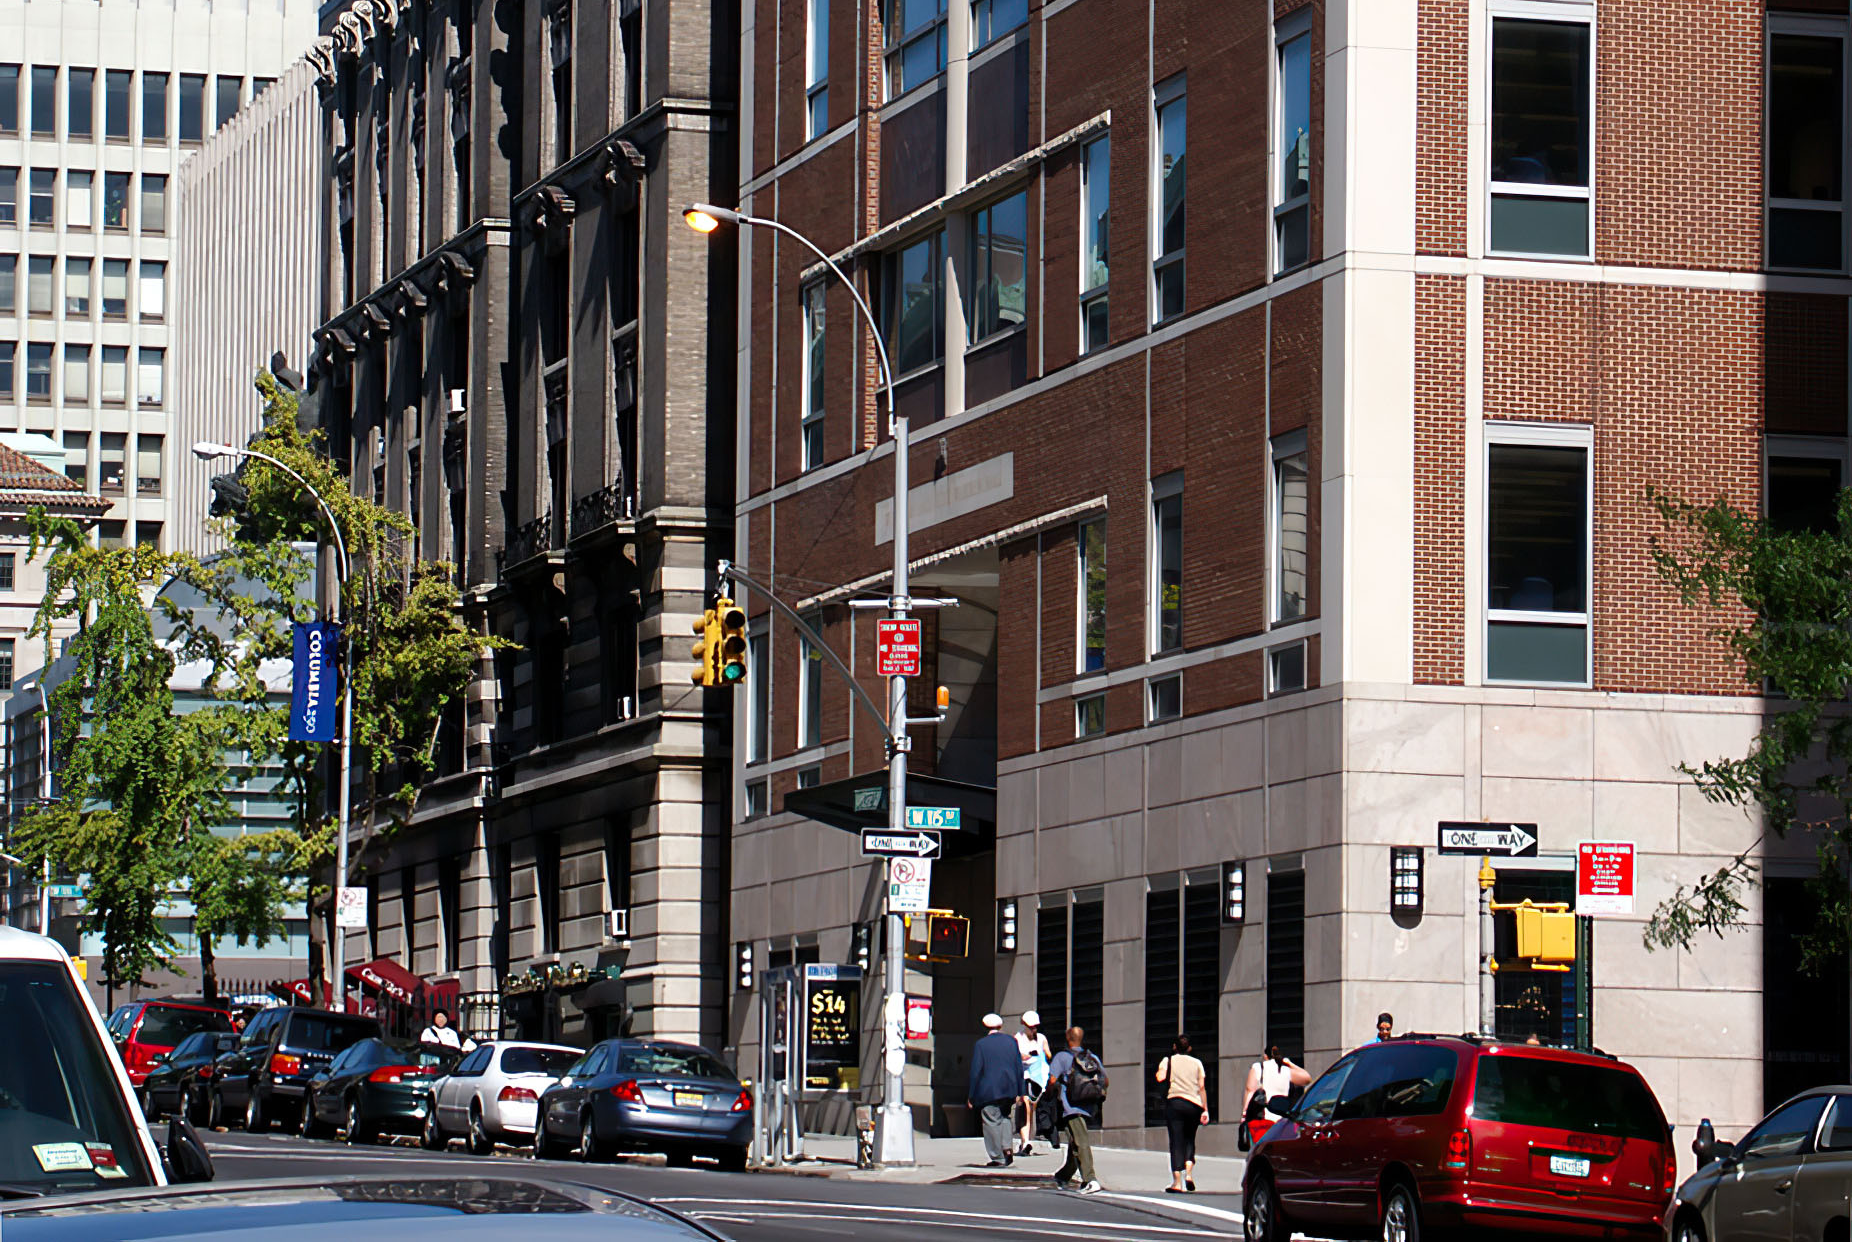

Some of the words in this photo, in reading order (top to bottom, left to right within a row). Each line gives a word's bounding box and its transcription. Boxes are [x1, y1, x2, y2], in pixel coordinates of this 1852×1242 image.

[307, 629, 322, 709] COLUMBIA
[1450, 831, 1478, 846] ONE
[1497, 833, 1526, 846] WAY
